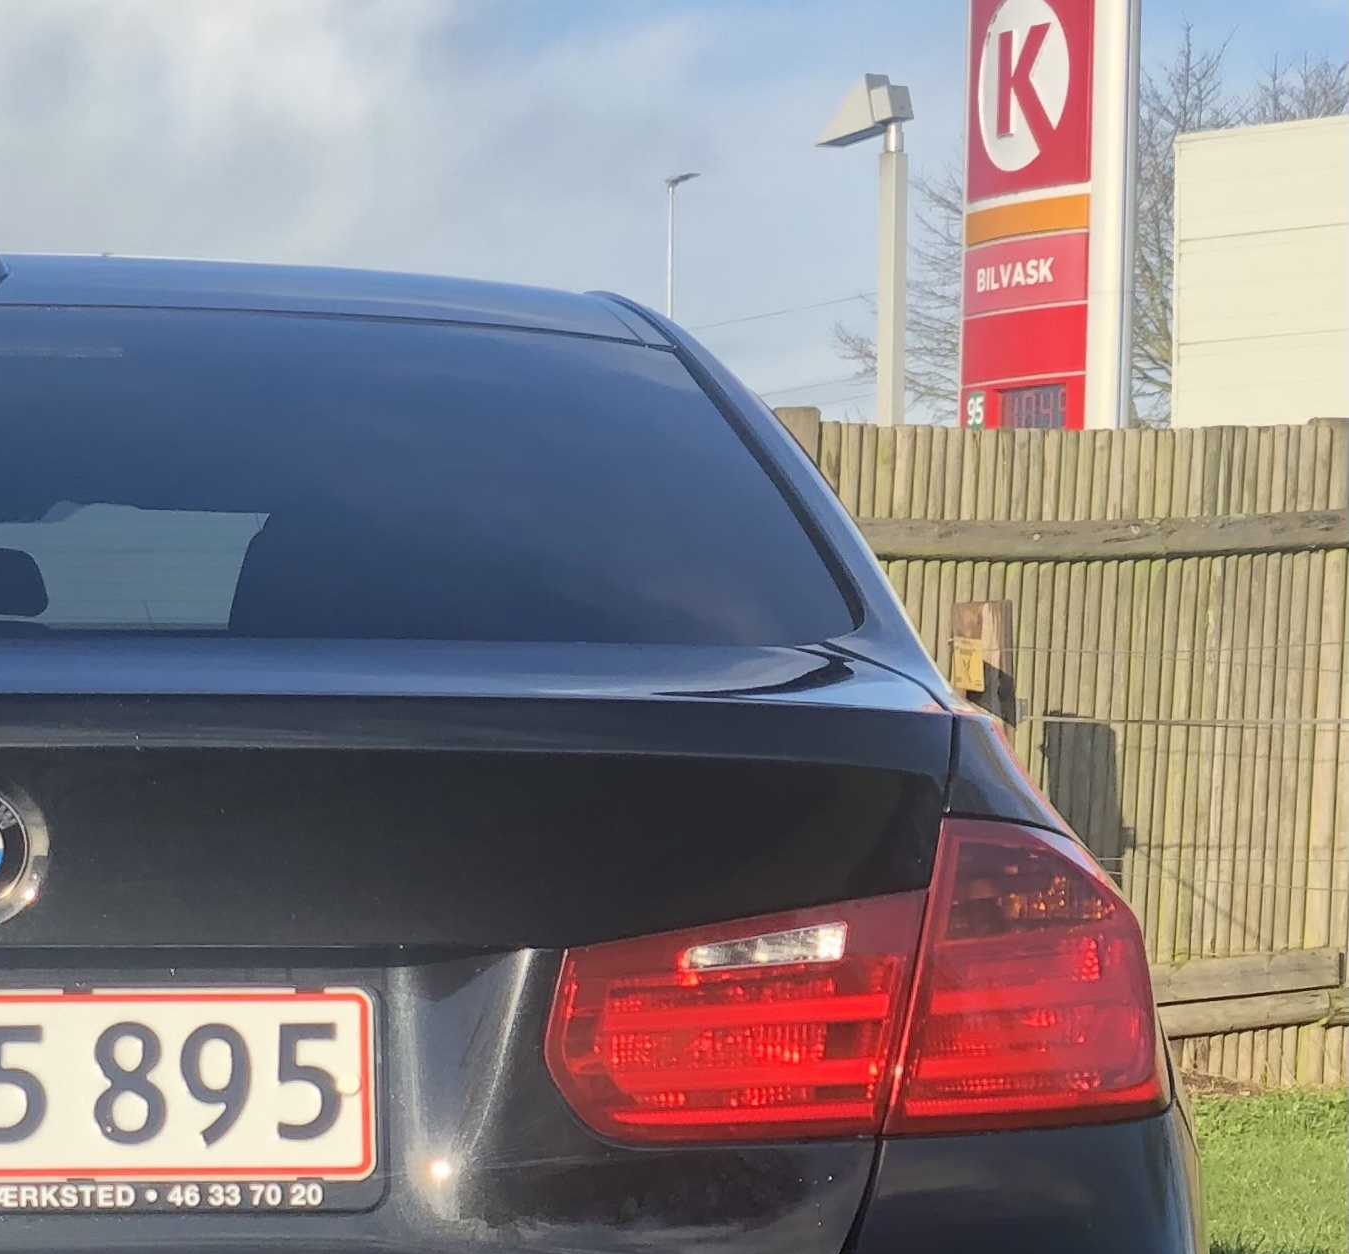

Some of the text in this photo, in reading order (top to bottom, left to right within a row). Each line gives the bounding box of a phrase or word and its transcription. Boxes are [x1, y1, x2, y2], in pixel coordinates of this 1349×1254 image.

[996, 21, 1056, 151] K
[976, 257, 1054, 293] BILVASK
[967, 396, 984, 426] 95
[93, 1020, 342, 1147] 895
[167, 1184, 201, 1208] 46
[208, 1183, 242, 1207] 33
[251, 1183, 282, 1206] 70
[289, 1182, 324, 1206] 20
